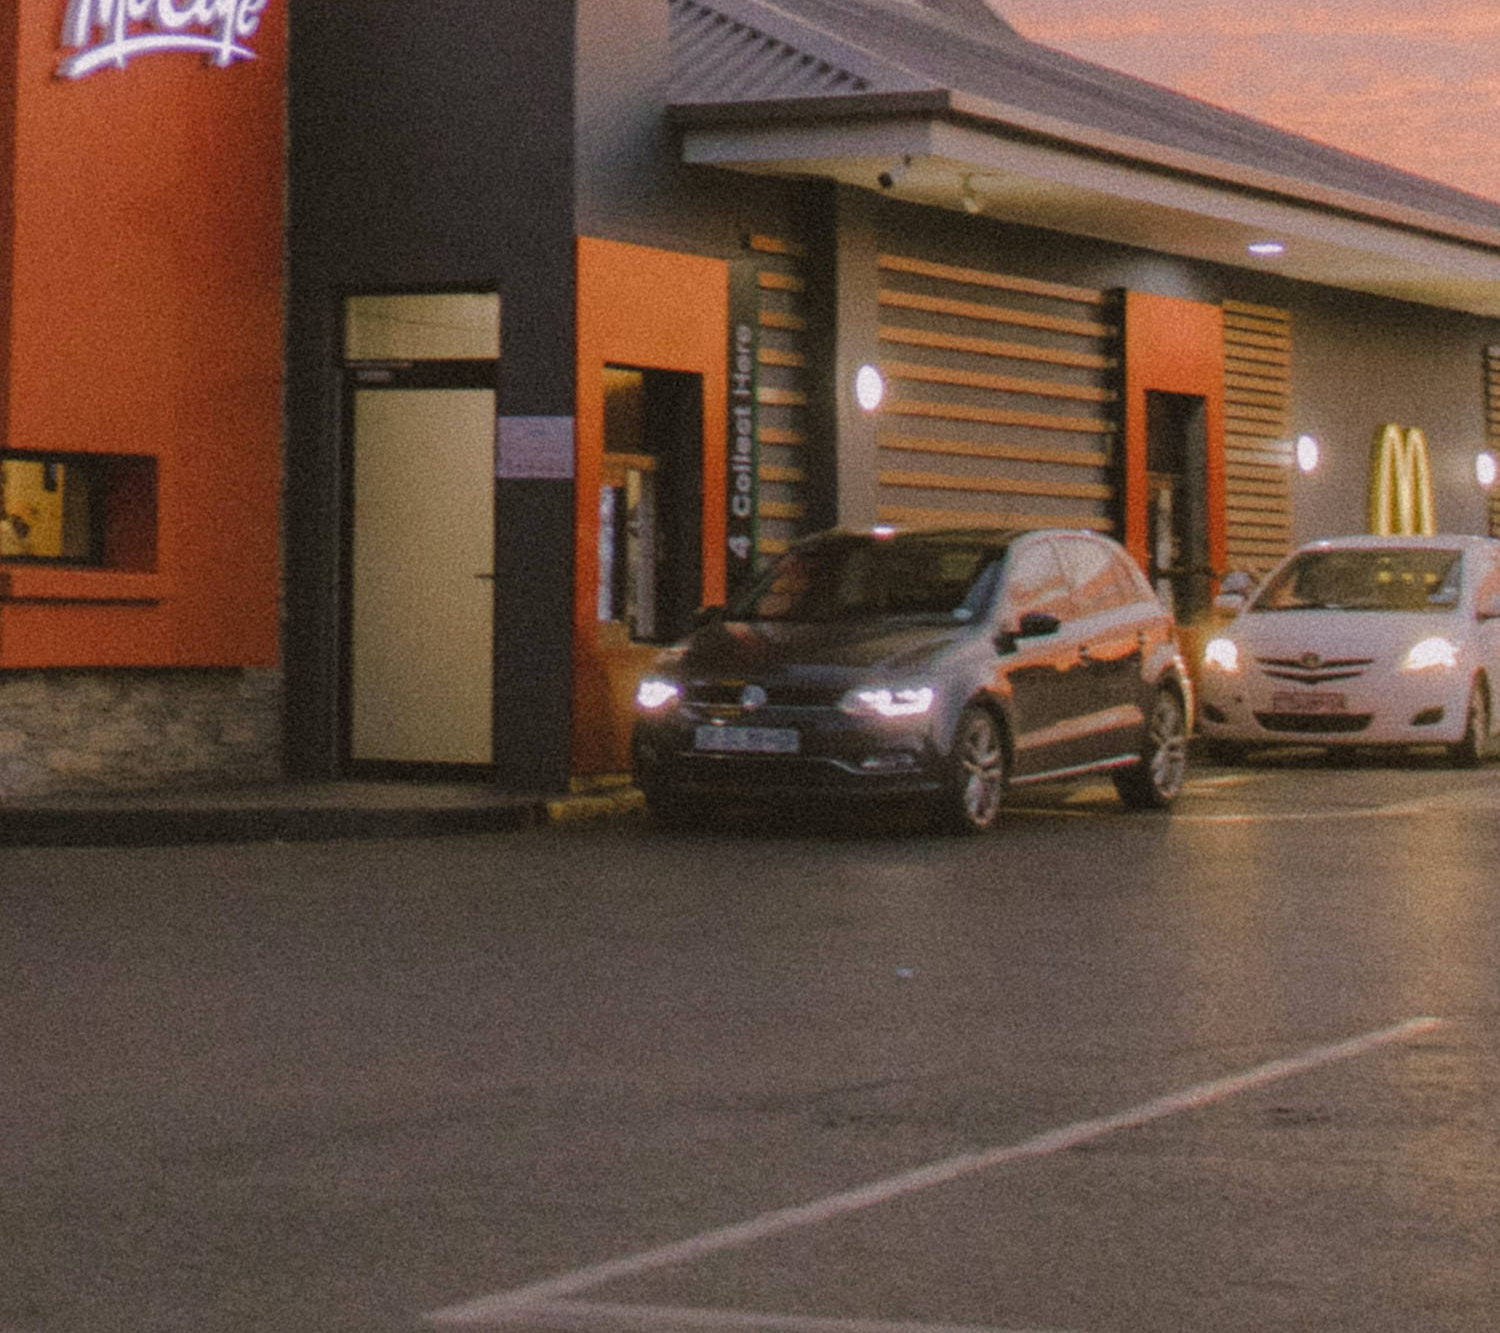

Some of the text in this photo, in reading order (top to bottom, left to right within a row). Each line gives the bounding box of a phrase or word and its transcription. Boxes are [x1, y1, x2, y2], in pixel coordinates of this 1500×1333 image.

[728, 325, 751, 560] 4 Collect Here
